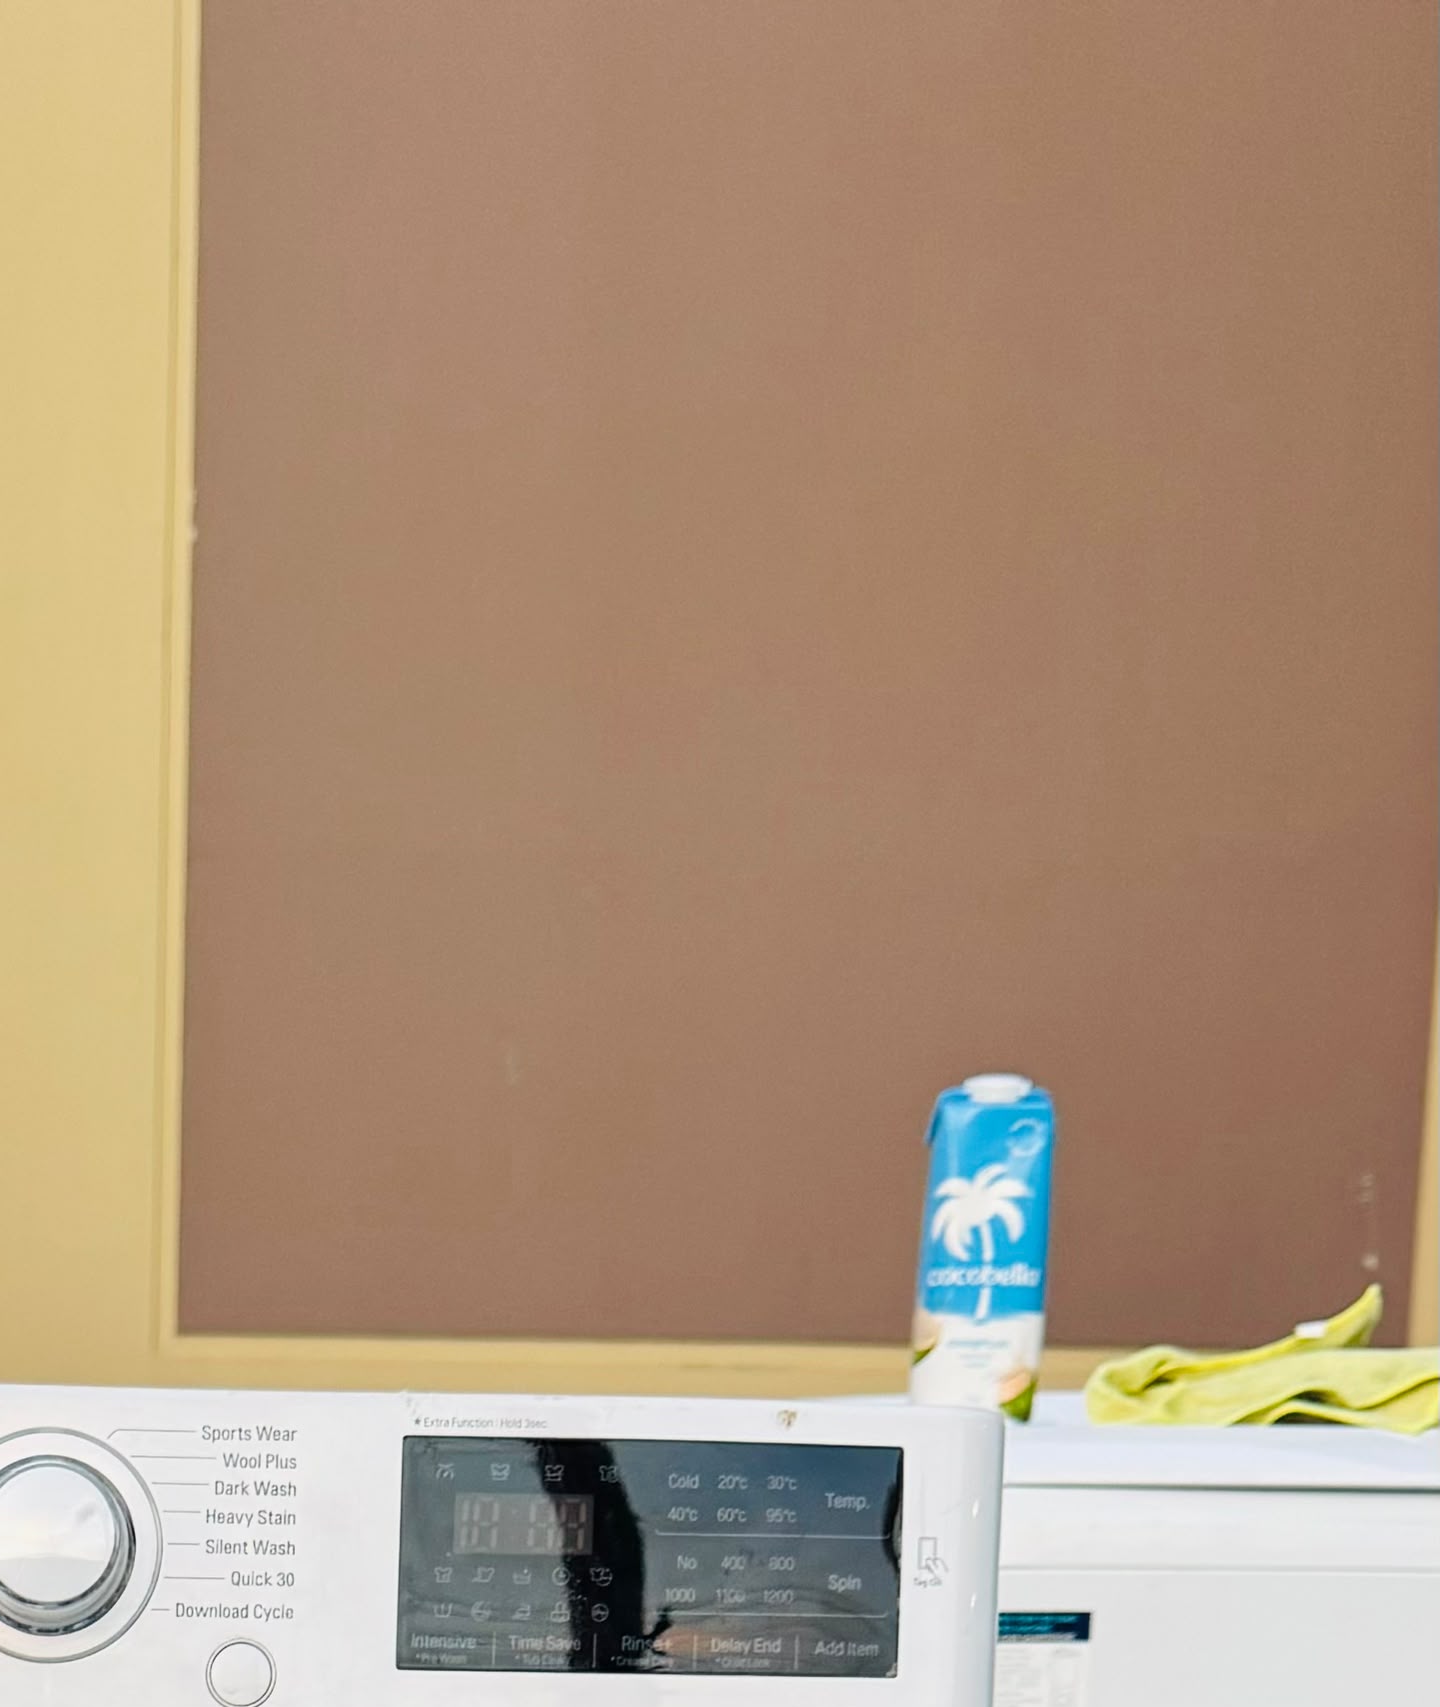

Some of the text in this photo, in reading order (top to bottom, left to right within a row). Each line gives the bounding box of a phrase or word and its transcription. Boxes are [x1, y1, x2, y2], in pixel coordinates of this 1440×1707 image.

[201, 1425, 298, 1443] Sports Wear
[223, 1452, 297, 1470] Wool Plus
[214, 1480, 297, 1497] Dark Wash
[668, 1473, 700, 1490] Cold
[824, 1492, 871, 1511] Temp.
[205, 1508, 297, 1528] Heavy Stain
[205, 1539, 296, 1556] Silent Wash
[676, 1555, 698, 1570] No
[720, 1556, 746, 1571] 400
[230, 1570, 295, 1588] Quick 30
[827, 1574, 863, 1593] Spin
[664, 1587, 696, 1602] 1000
[763, 1588, 794, 1603] 1200
[175, 1602, 294, 1623] Download Cycle
[411, 1633, 477, 1650] Intensive
[509, 1635, 582, 1651] Time Save
[711, 1637, 783, 1657] Delay End
[814, 1640, 880, 1657] Add Item
